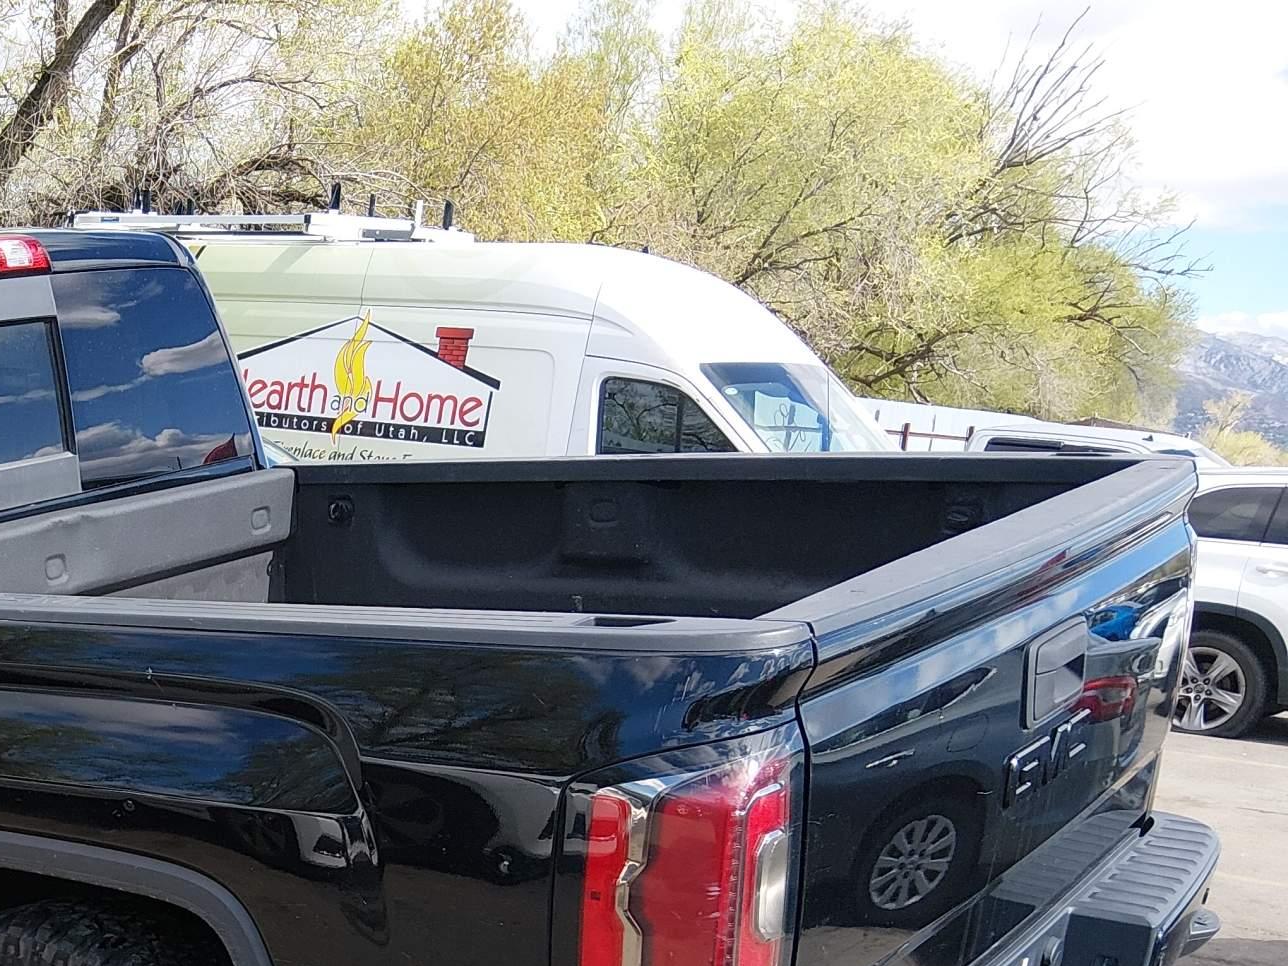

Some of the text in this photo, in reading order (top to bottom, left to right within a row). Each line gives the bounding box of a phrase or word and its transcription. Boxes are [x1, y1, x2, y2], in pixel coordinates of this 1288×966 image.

[243, 369, 482, 427] earth and Home
[344, 422, 363, 435] of
[376, 424, 427, 443] Utah,
[442, 431, 476, 446] LLC
[1002, 707, 1091, 809] GMC
